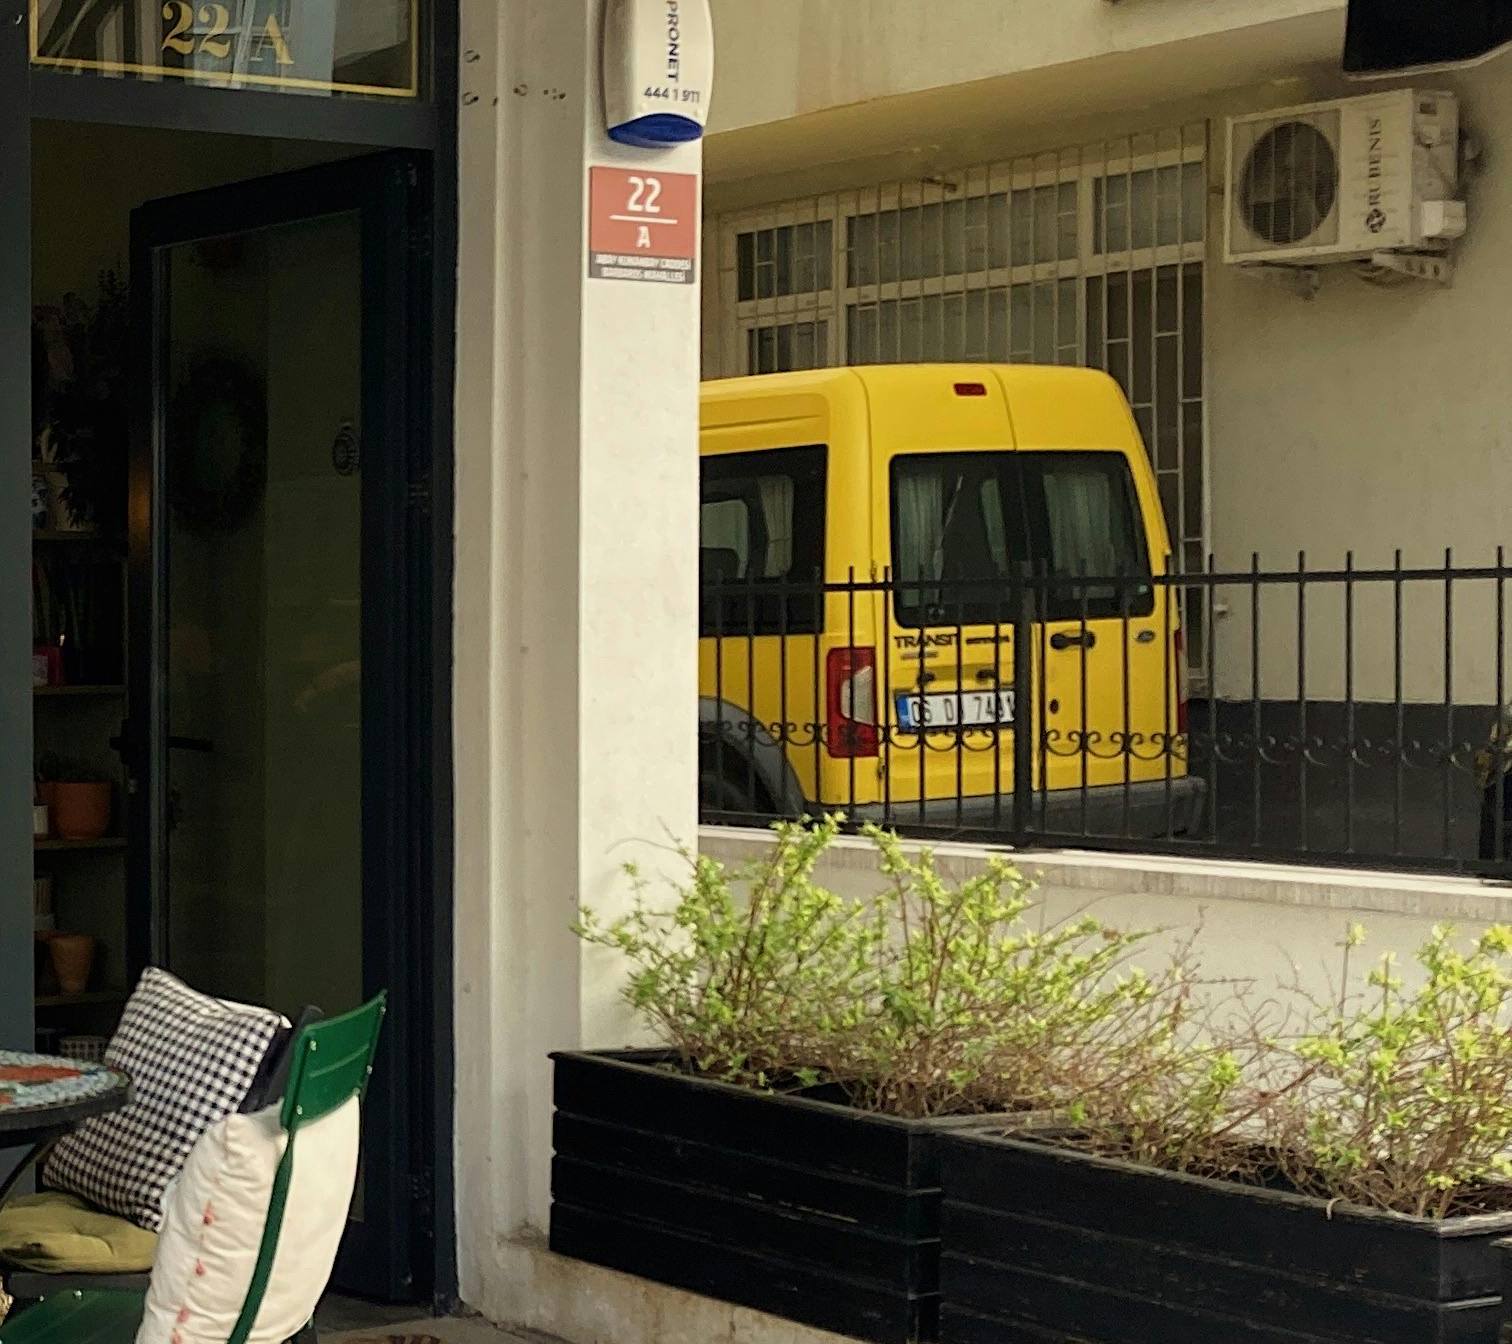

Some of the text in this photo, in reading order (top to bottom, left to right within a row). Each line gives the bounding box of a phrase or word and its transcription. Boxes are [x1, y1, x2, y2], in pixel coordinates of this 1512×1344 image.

[666, 0, 679, 83] PRONET
[644, 87, 669, 98] 444
[1368, 118, 1382, 206] RUBENIS
[627, 176, 661, 213] 22
[636, 226, 650, 248] A
